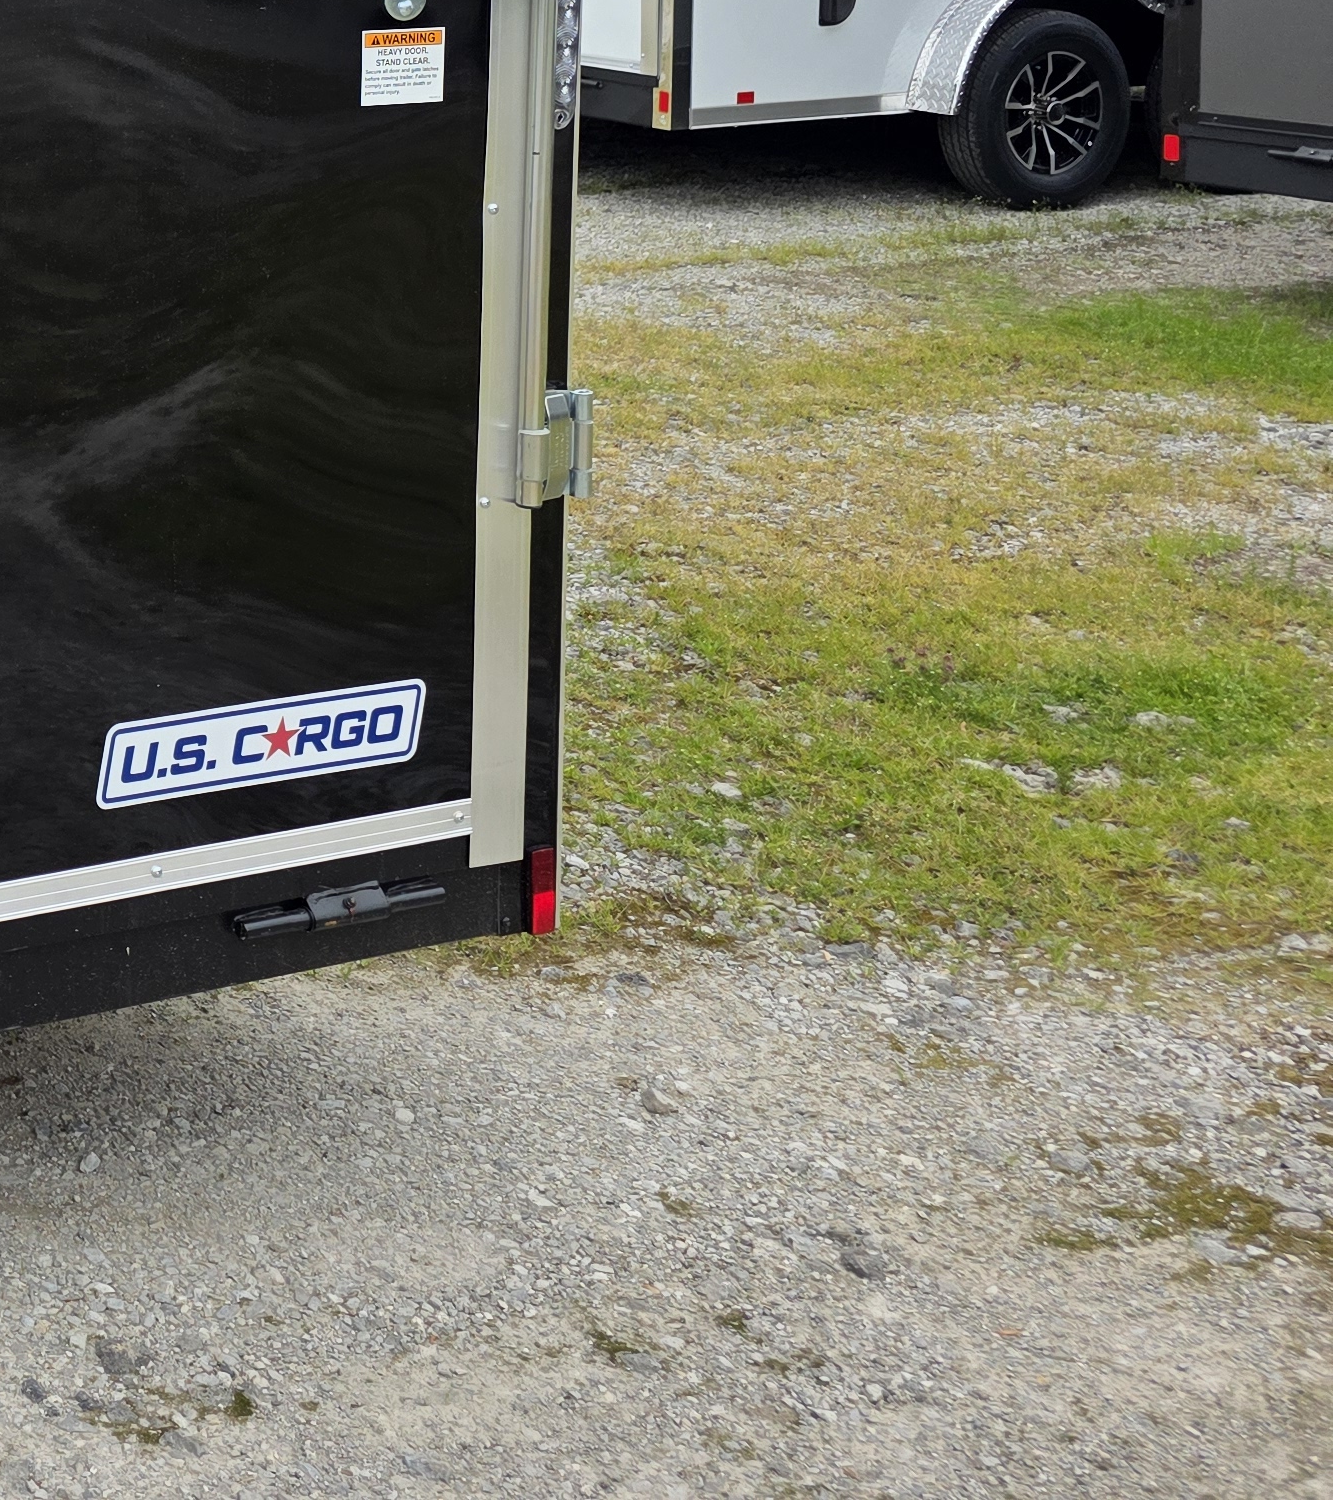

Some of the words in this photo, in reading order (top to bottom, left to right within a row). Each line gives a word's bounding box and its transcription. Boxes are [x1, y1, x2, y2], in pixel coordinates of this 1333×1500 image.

[382, 32, 436, 45] WARNING
[377, 47, 403, 56] HEAVY
[375, 58, 401, 67] STAND
[120, 734, 217, 784] U.S.
